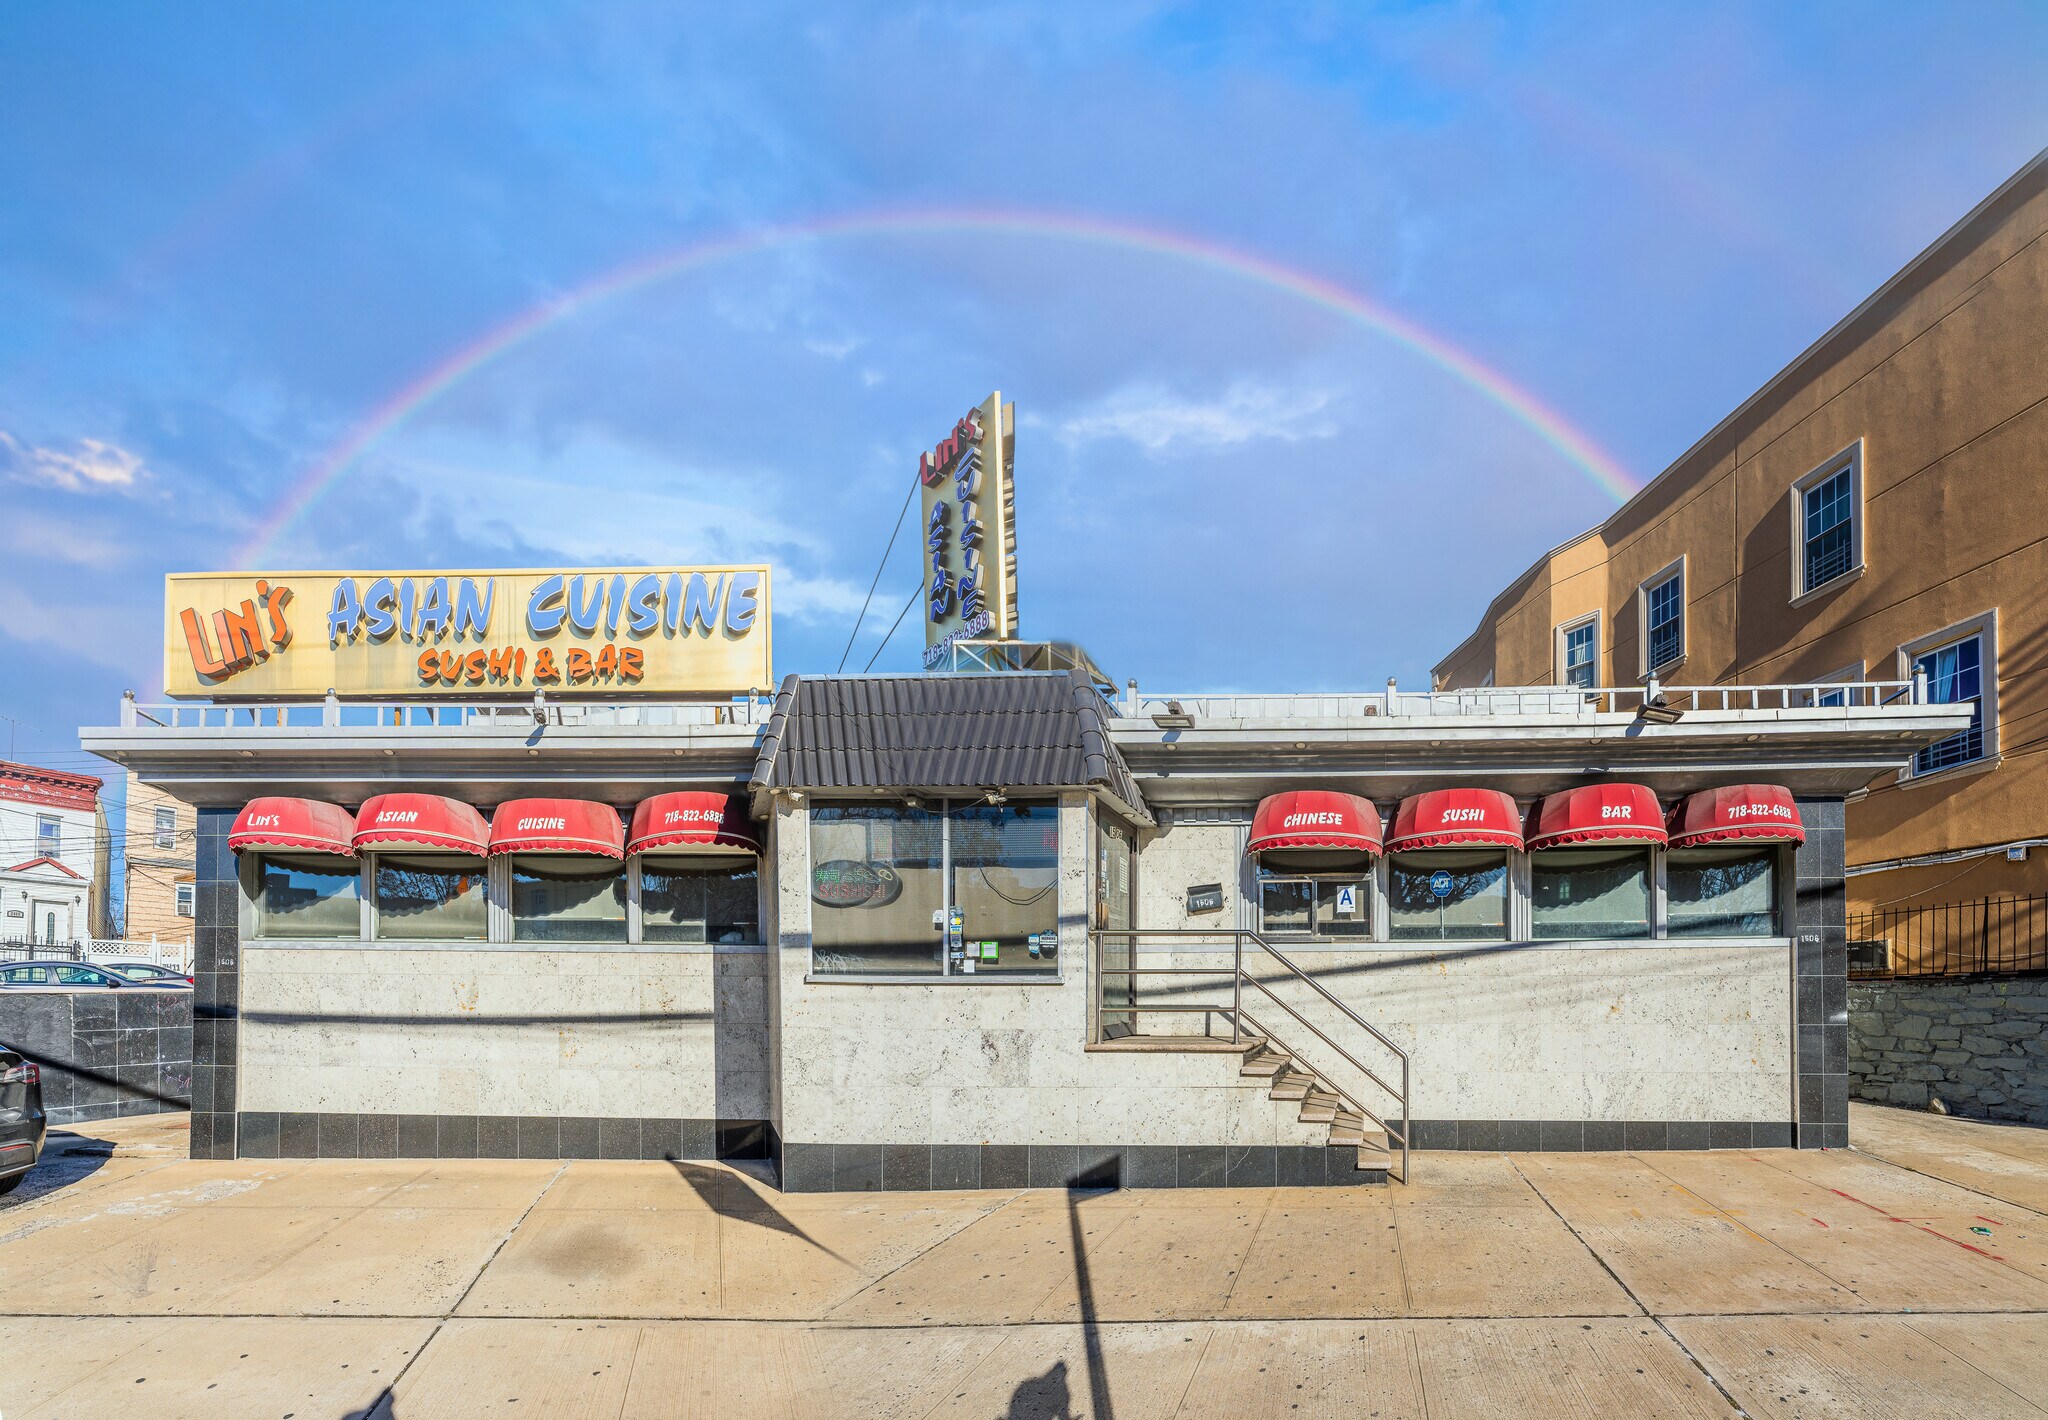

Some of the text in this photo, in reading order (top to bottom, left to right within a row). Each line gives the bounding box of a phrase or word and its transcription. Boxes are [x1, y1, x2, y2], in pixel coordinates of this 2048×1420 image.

[953, 447, 984, 620] CUISINE
[928, 499, 951, 623] ASIAN
[328, 571, 760, 642] ASIAN CUISINE
[418, 646, 526, 680] SUSHI
[567, 644, 645, 679] BAR
[376, 811, 419, 823] ASIAN
[665, 809, 725, 824] 718-822-6888
[1441, 808, 1486, 823] SUSHI
[1601, 806, 1632, 819] BAR
[1728, 804, 1792, 819] 718-822-6888
[518, 817, 566, 830] CUISINE
[1284, 812, 1343, 828] CHINESE
[1433, 877, 1450, 889] ADT
[1340, 888, 1352, 905] A
